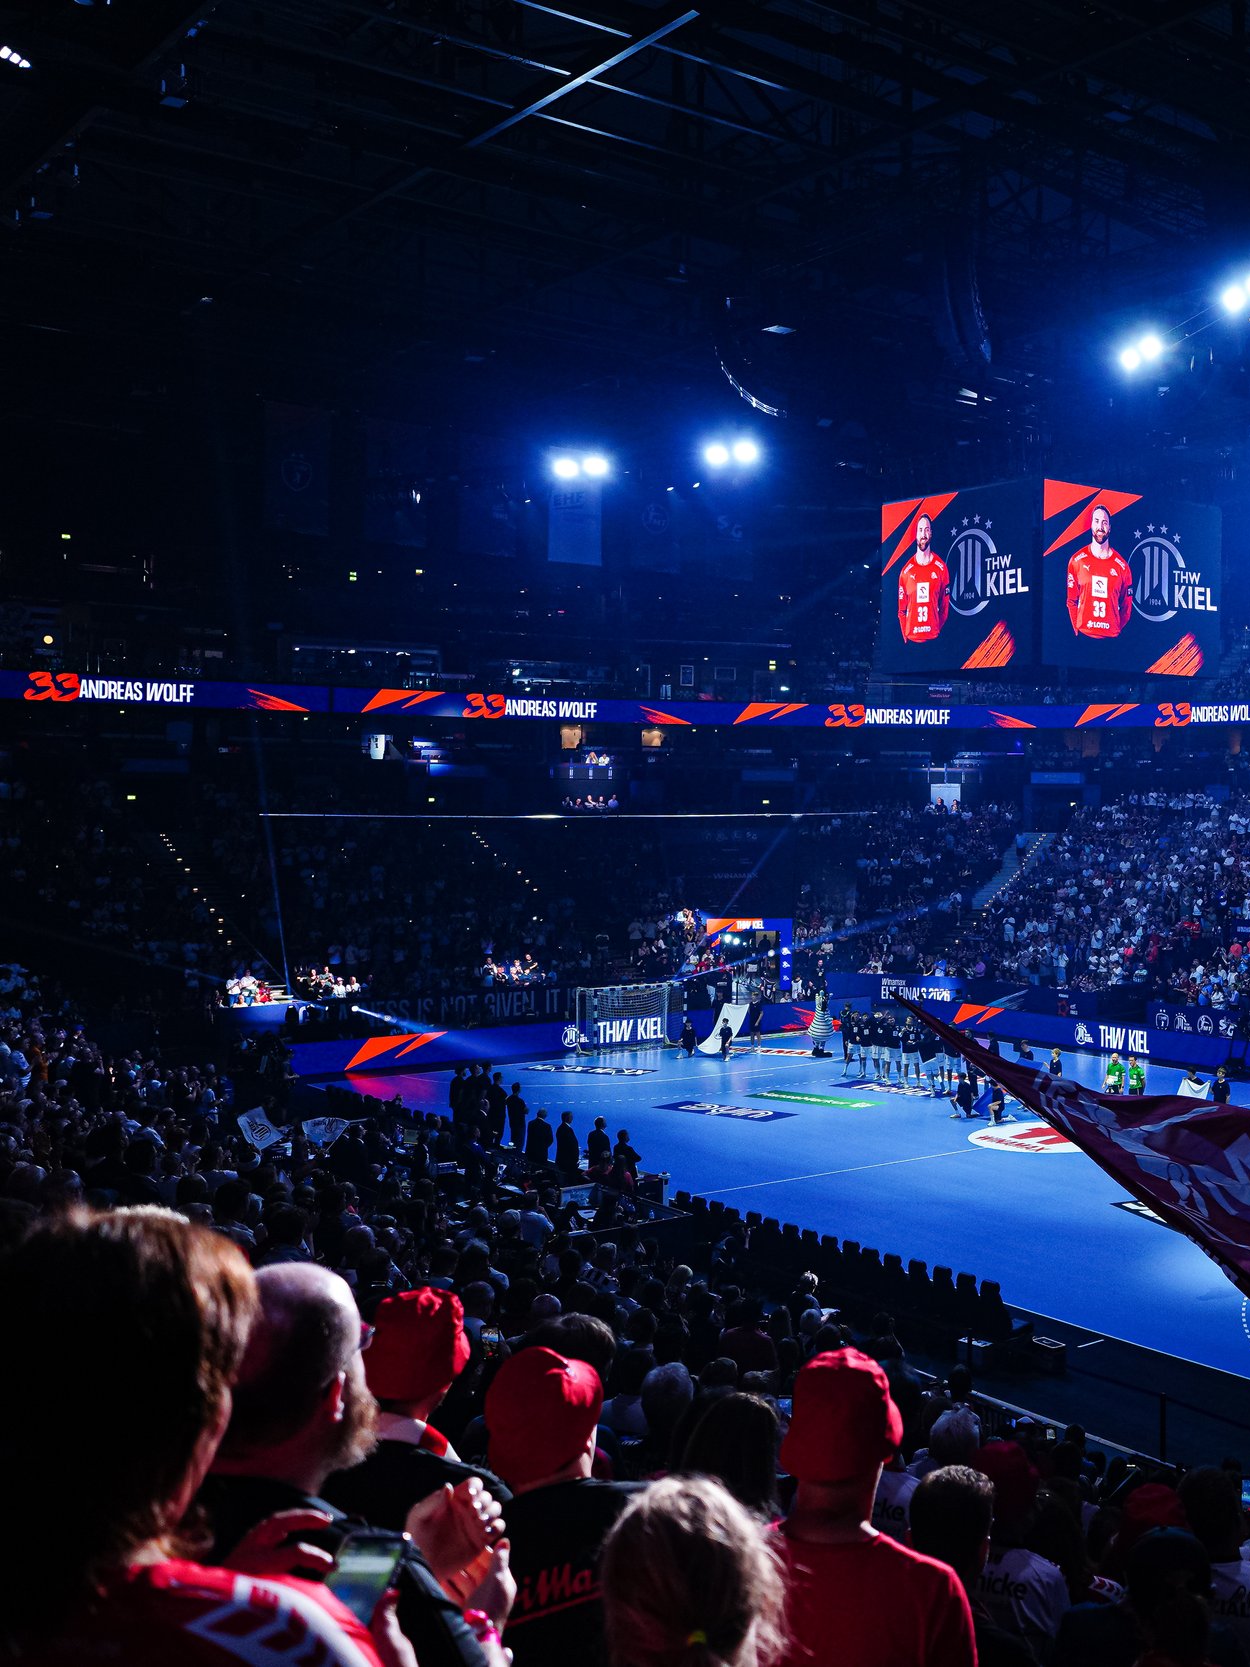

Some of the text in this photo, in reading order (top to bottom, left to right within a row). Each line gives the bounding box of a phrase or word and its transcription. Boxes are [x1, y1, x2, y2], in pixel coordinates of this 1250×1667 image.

[985, 554, 1012, 571] THW
[986, 568, 1029, 597] KIEL
[1173, 570, 1201, 585] THW
[1092, 601, 1107, 618] 33
[1174, 585, 1218, 612] KIEL
[917, 606, 929, 622] 33
[24, 671, 194, 702] 33 ANDREAS WOLFF
[462, 693, 597, 719] 33 ANDREAS WOLFF
[825, 704, 950, 727] 33 ANDREAS WOLFF
[1154, 703, 1191, 727] 33
[1190, 706, 1228, 722] ANDREAS
[597, 1016, 664, 1044] THW KIEL
[1099, 1025, 1150, 1054] THW KIEL
